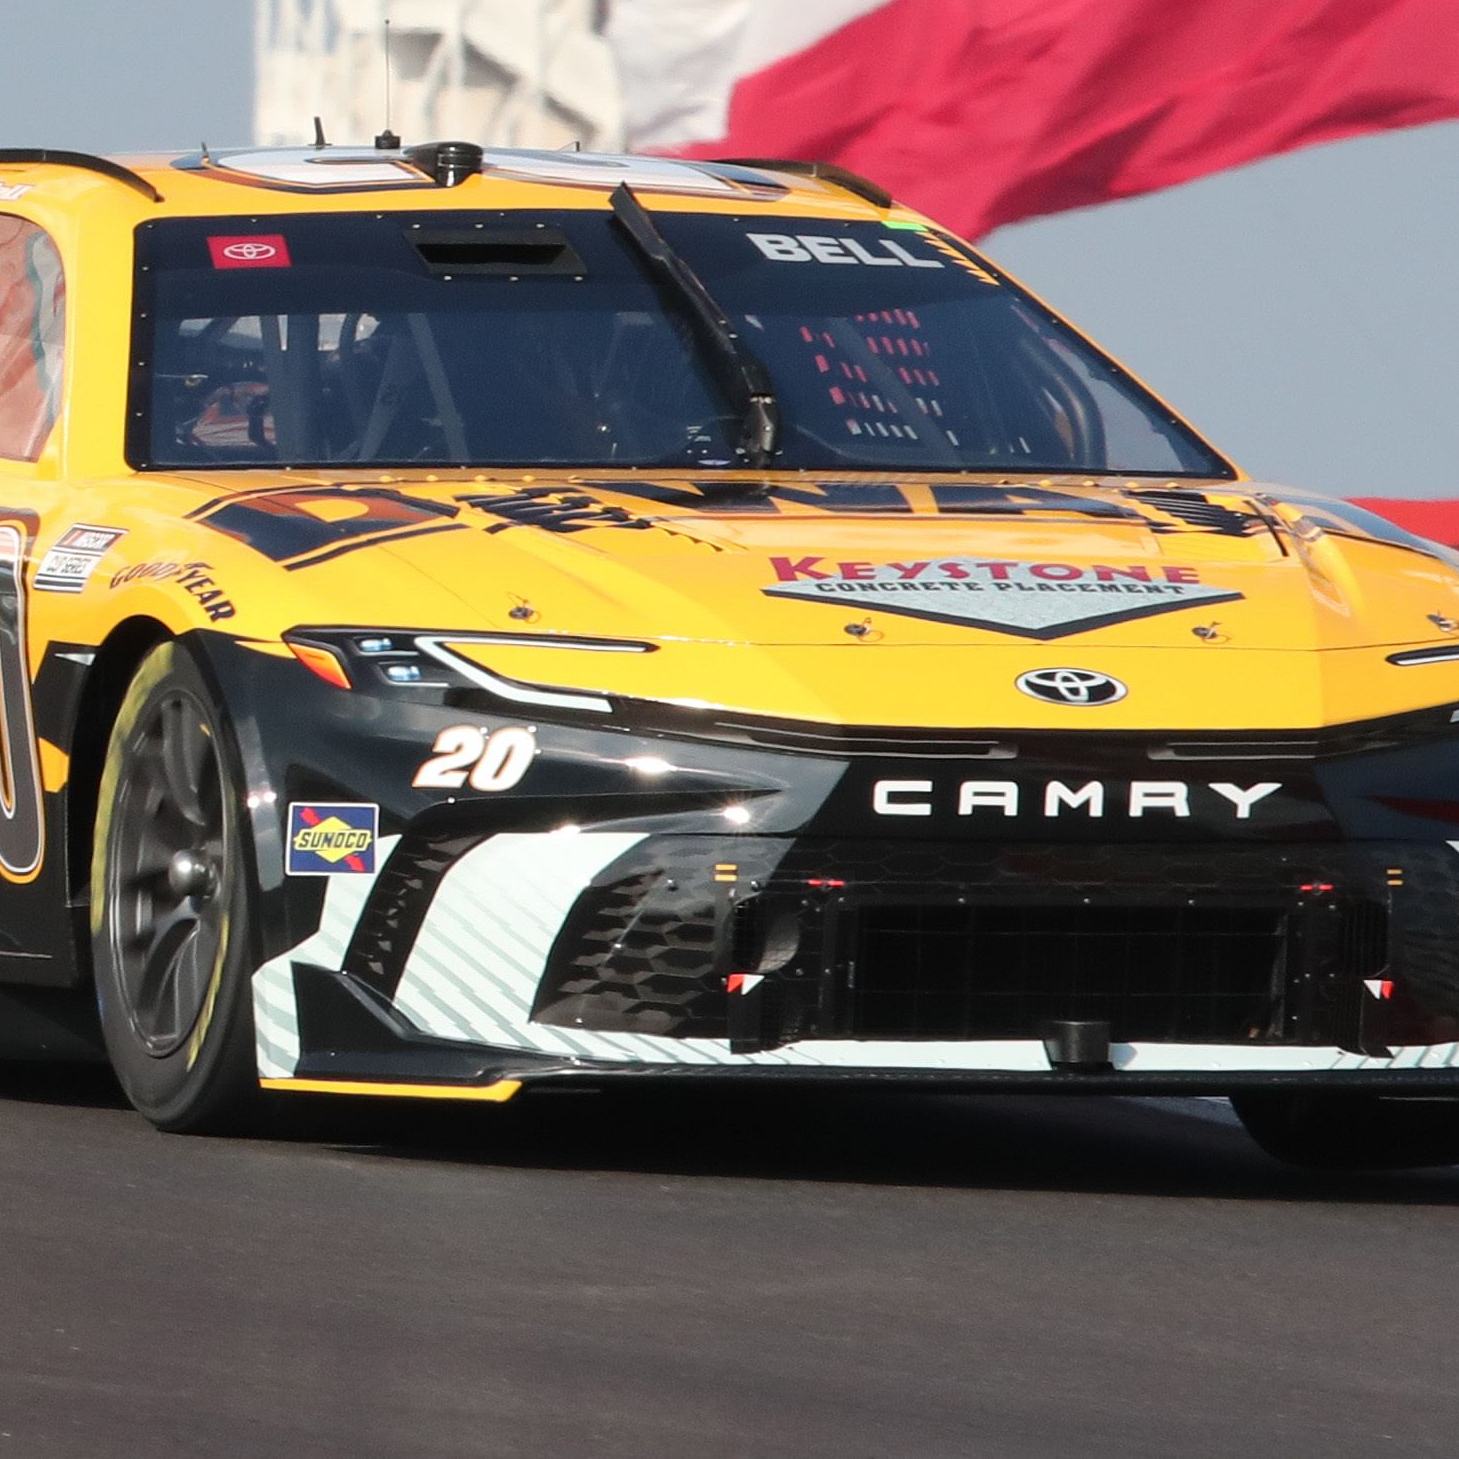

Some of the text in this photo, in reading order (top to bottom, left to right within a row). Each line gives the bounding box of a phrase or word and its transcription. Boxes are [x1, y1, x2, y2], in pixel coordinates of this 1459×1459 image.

[746, 233, 945, 268] BELL
[769, 556, 1200, 584] KEYSTONE
[110, 562, 236, 623] GOODYEAR
[815, 581, 1184, 595] CONCRETE PLACEMENT
[411, 724, 537, 792] 20
[873, 780, 1283, 818] CAMRY
[297, 831, 370, 849] SUNOCO
